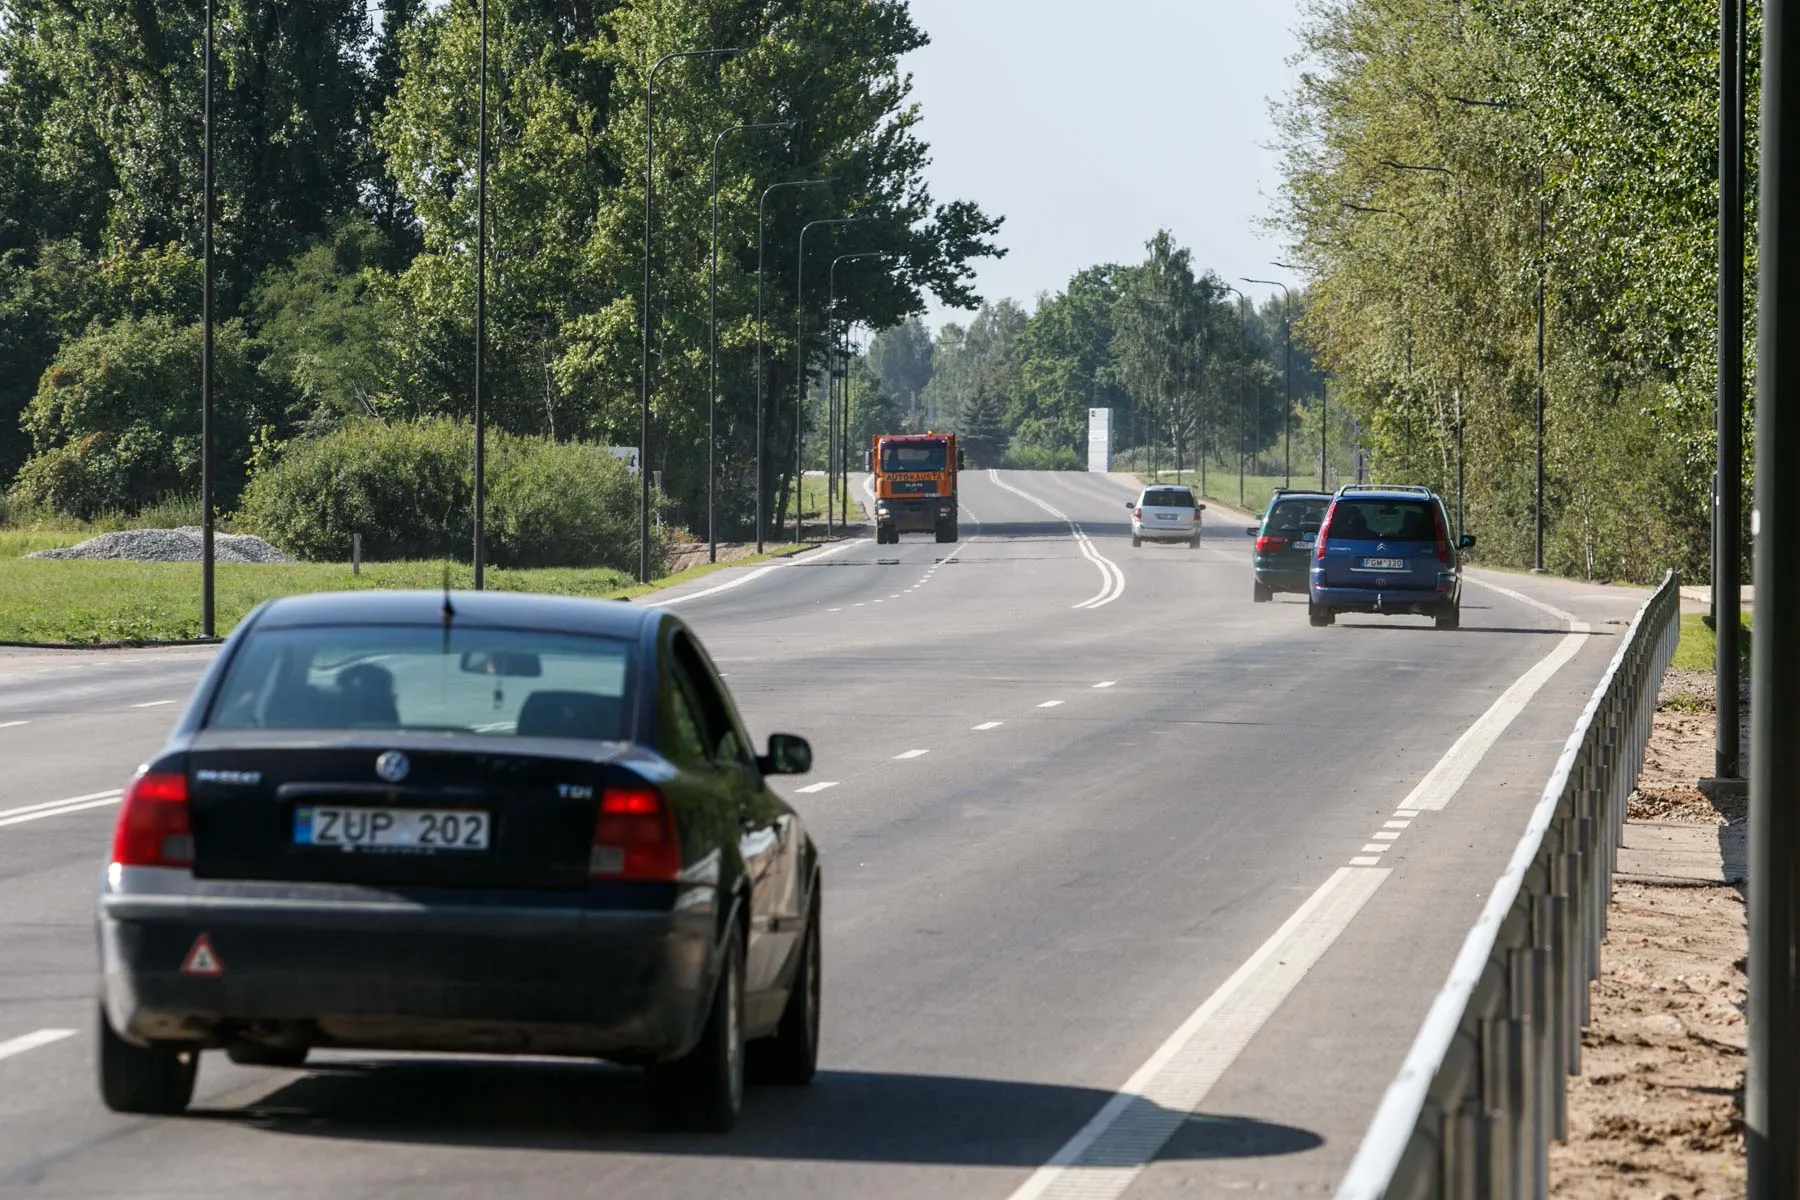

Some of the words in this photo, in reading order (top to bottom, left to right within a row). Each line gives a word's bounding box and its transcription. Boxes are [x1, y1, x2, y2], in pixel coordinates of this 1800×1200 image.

[887, 473, 942, 481] AUTOKAUSTA
[1365, 559, 1383, 567] FGM
[559, 783, 593, 799] TDI
[317, 811, 395, 842] ZUP
[418, 813, 483, 846] 202
